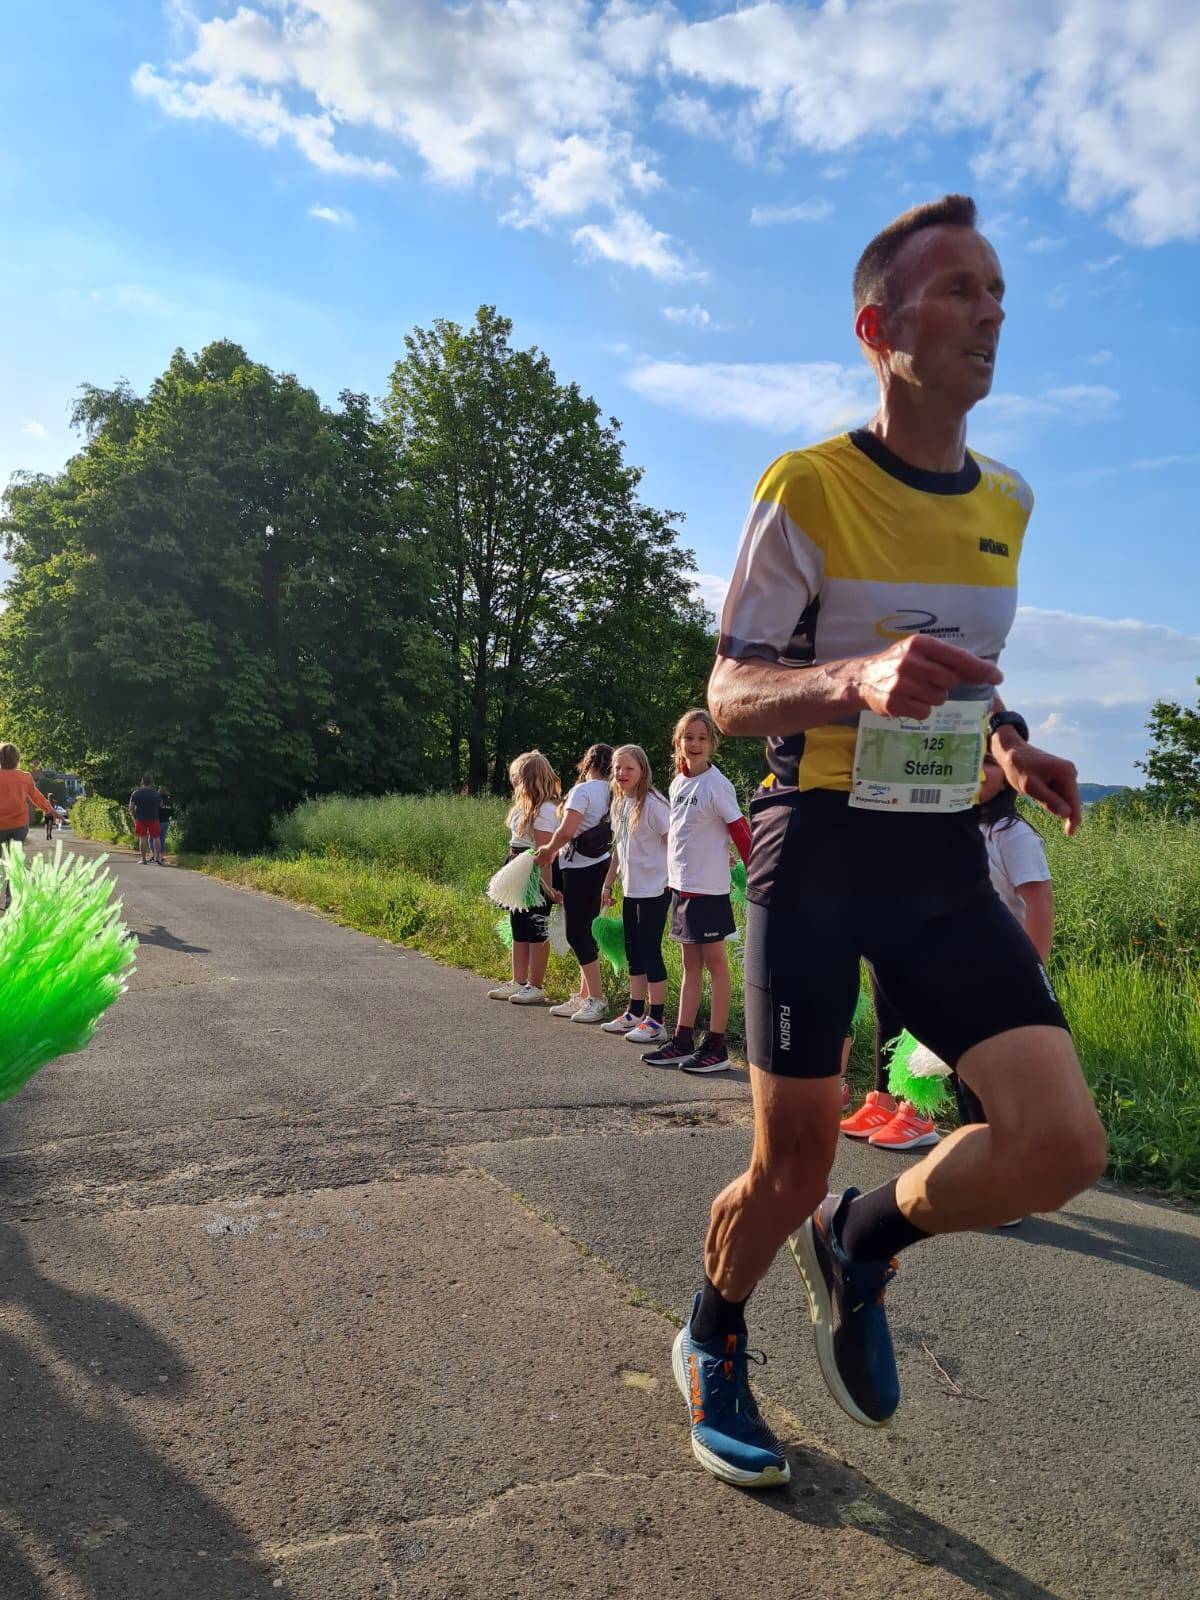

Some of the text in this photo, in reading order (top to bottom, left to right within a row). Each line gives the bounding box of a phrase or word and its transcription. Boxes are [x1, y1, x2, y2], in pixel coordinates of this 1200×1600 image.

[922, 737, 944, 751] 125
[904, 760, 953, 776] Stefan
[780, 1004, 791, 1051] FUSION
